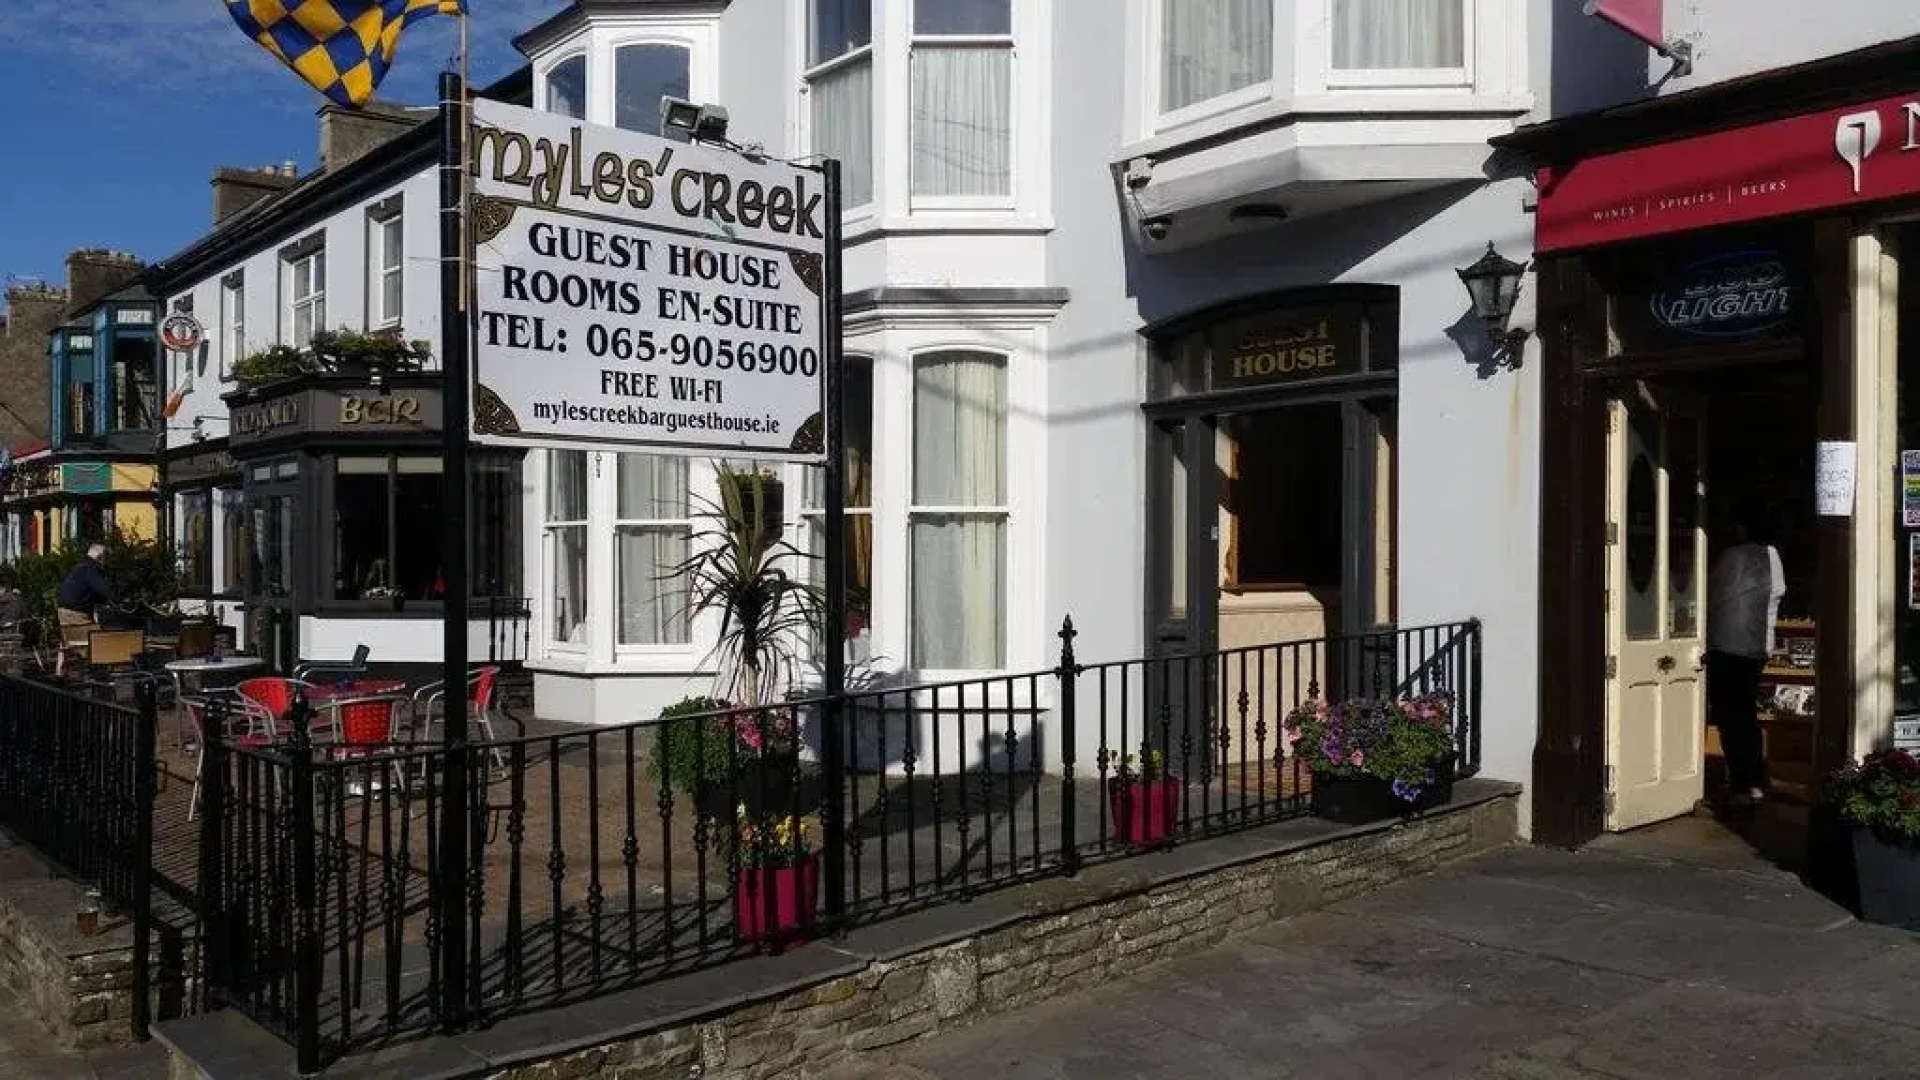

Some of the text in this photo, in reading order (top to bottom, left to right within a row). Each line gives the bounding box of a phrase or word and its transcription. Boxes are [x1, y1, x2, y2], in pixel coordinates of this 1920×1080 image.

[1593, 180, 1787, 220] WINES SPIRITS BEERS
[528, 222, 781, 289] GUEST HOUSE
[502, 265, 803, 334] ROOMS EN-SUITE
[481, 310, 818, 377] TEL: 065-9056900
[1231, 345, 1336, 378] HOUSE
[600, 370, 723, 404] FREE WI-FI
[533, 400, 780, 434] mylescreekbarguesthouse.ie
